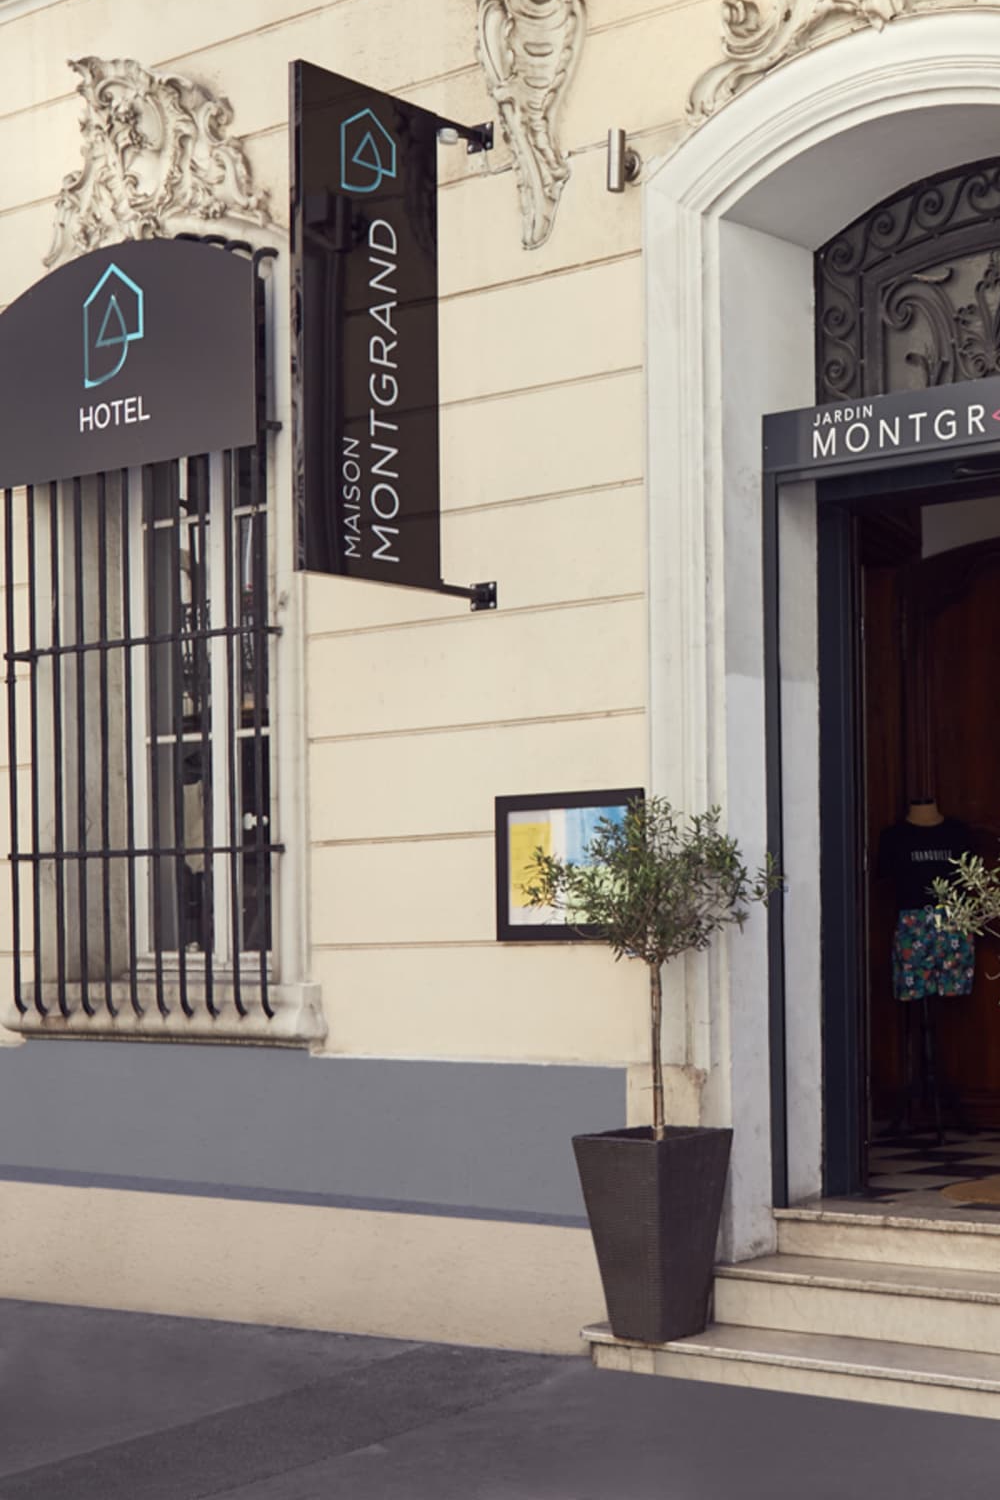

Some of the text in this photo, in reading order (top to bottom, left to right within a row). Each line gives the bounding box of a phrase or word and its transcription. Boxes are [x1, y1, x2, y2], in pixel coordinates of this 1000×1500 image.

[79, 396, 151, 433] HOTEL
[369, 219, 400, 562] MONTGRAND
[813, 404, 873, 427] JARDIN
[343, 437, 361, 558] MAISON
